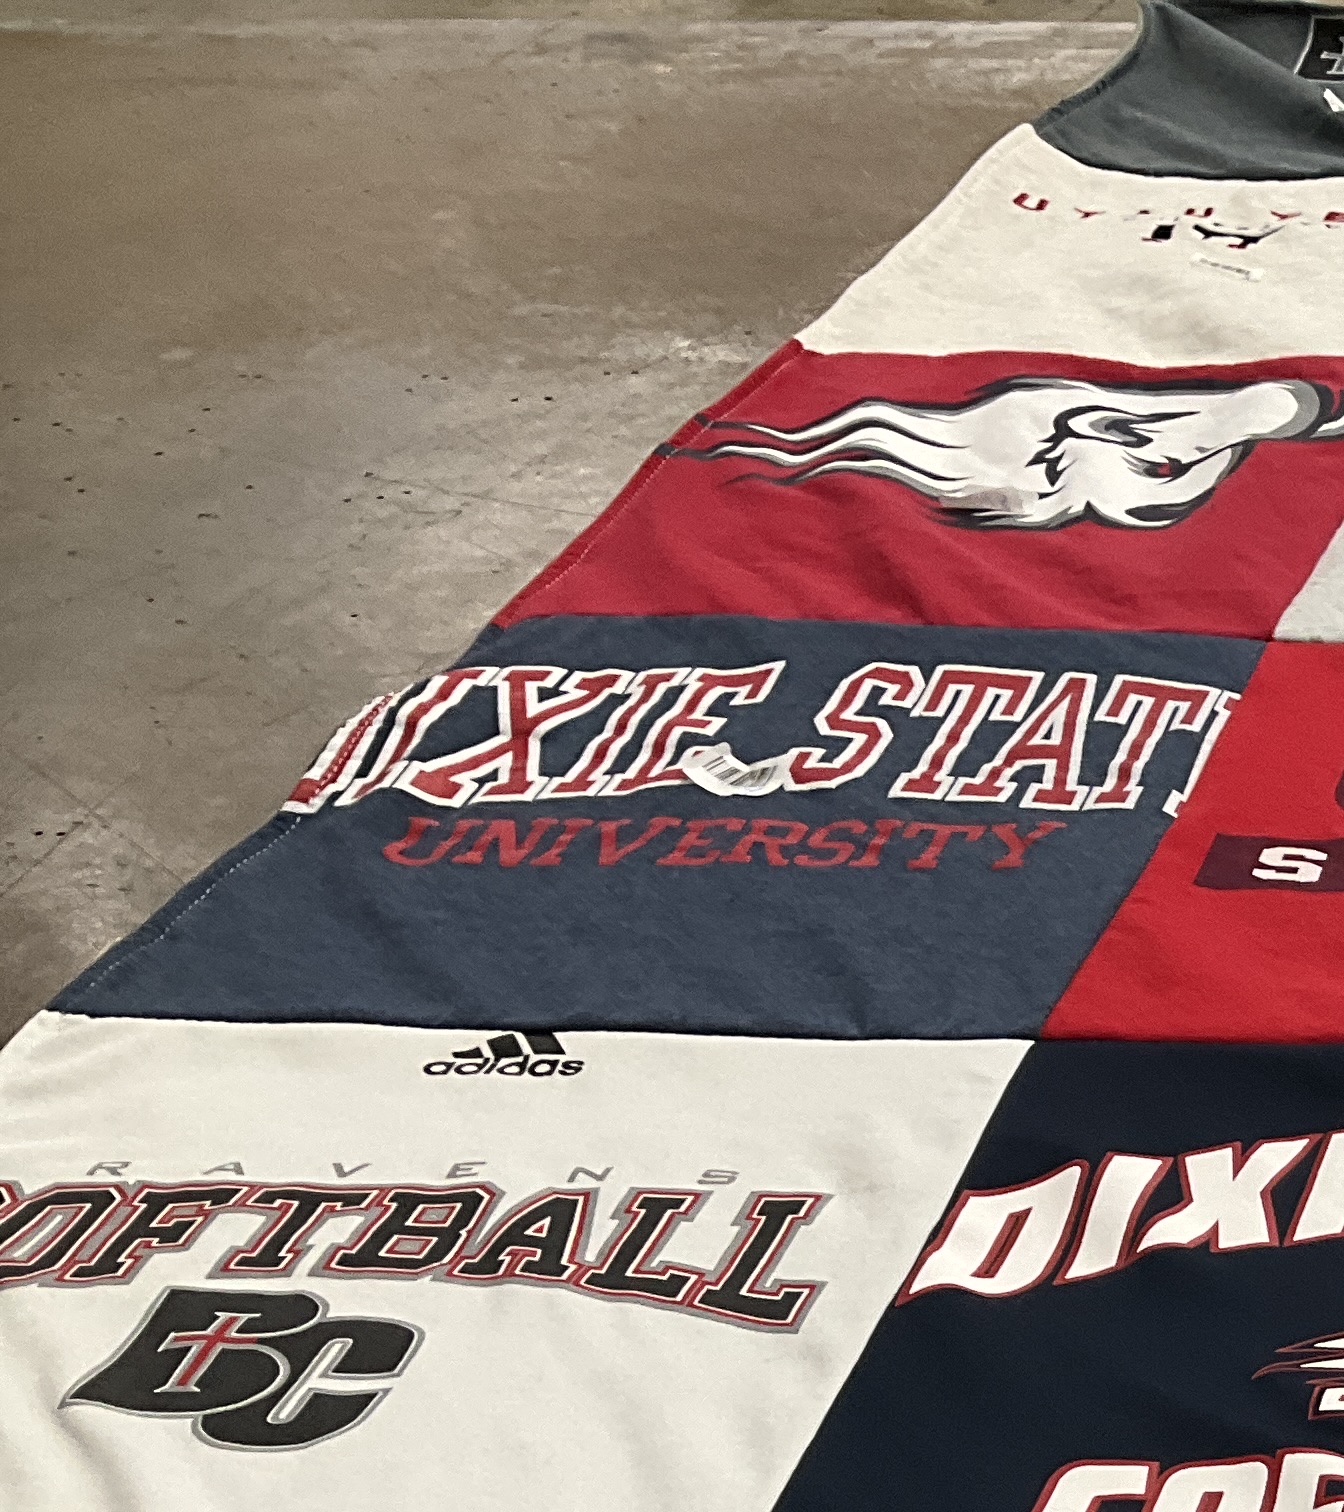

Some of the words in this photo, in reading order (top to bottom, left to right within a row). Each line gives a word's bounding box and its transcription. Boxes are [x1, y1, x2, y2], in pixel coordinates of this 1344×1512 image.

[790, 661, 1245, 820] STAT
[382, 814, 1068, 870] UNIVERSITY
[422, 1055, 586, 1079] adidas
[86, 1160, 741, 1188] RAVENS
[0, 1179, 835, 1333] OFTBALL
